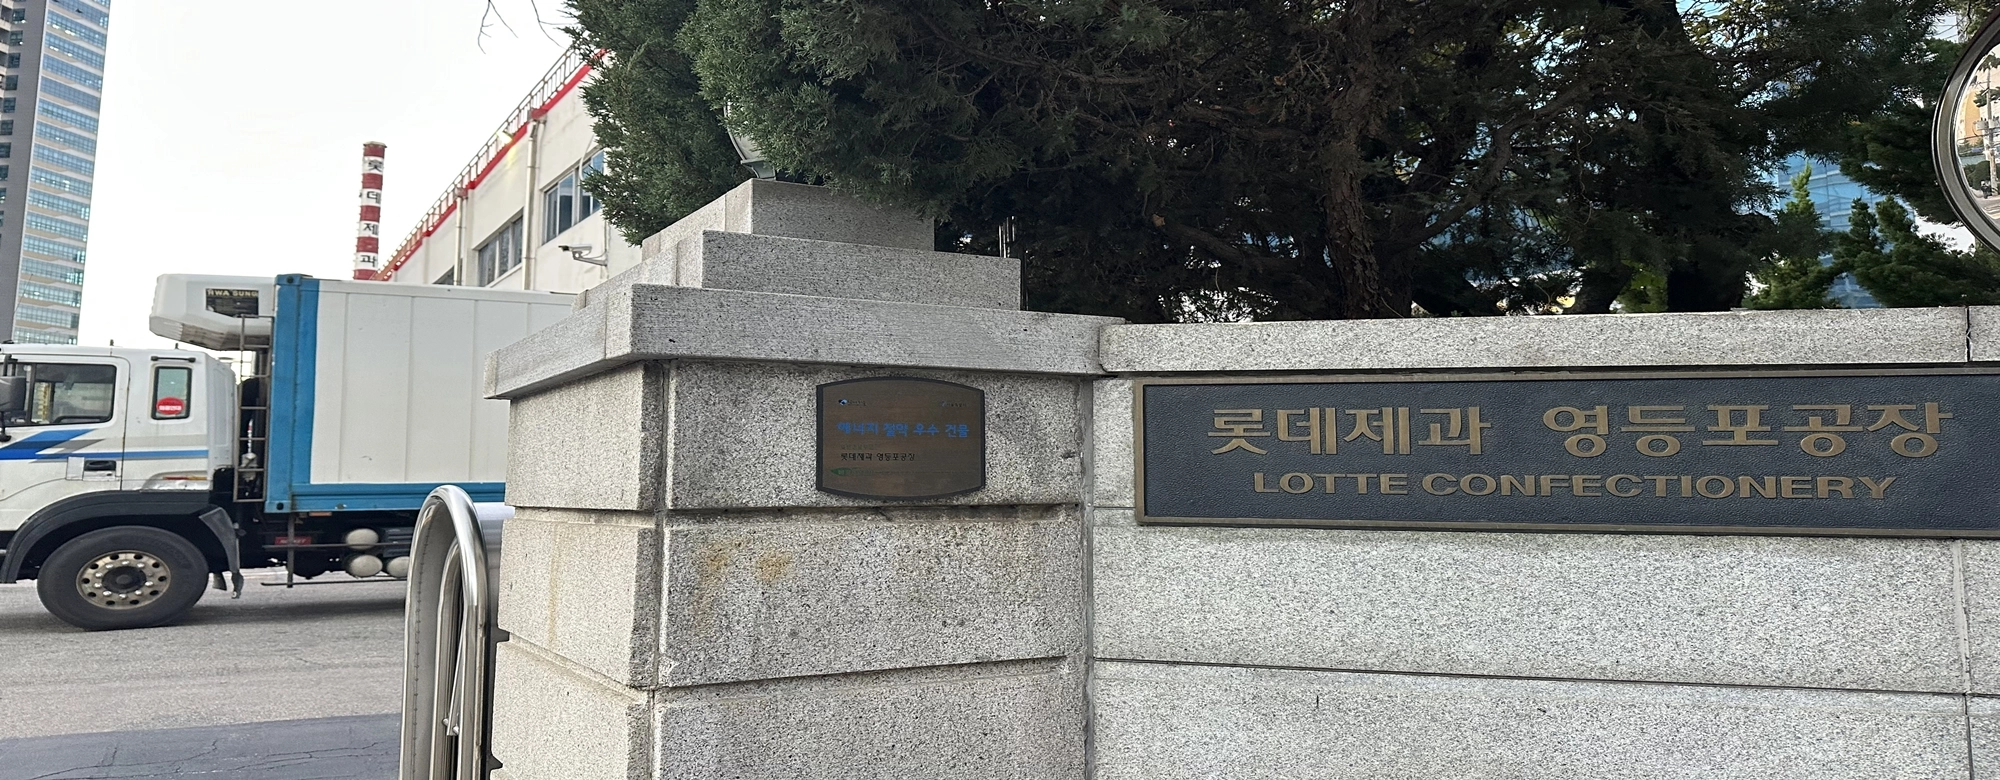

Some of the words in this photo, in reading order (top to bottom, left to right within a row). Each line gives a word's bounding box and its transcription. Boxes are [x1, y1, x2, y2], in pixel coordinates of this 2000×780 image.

[207, 289, 230, 297] HWA
[232, 290, 258, 298] SUNG
[836, 422, 879, 436] 에너지
[883, 422, 909, 438] 절약
[913, 423, 940, 436] 우수
[945, 424, 970, 438] 건물
[1207, 406, 1492, 455] 롯데제과
[1542, 402, 1954, 458] 영등포공장
[840, 452, 873, 462] 롯데제과
[876, 452, 916, 462] 영등포공장
[1254, 472, 1409, 496] LOTTE
[1420, 472, 1897, 500] CONFECTIONERY
